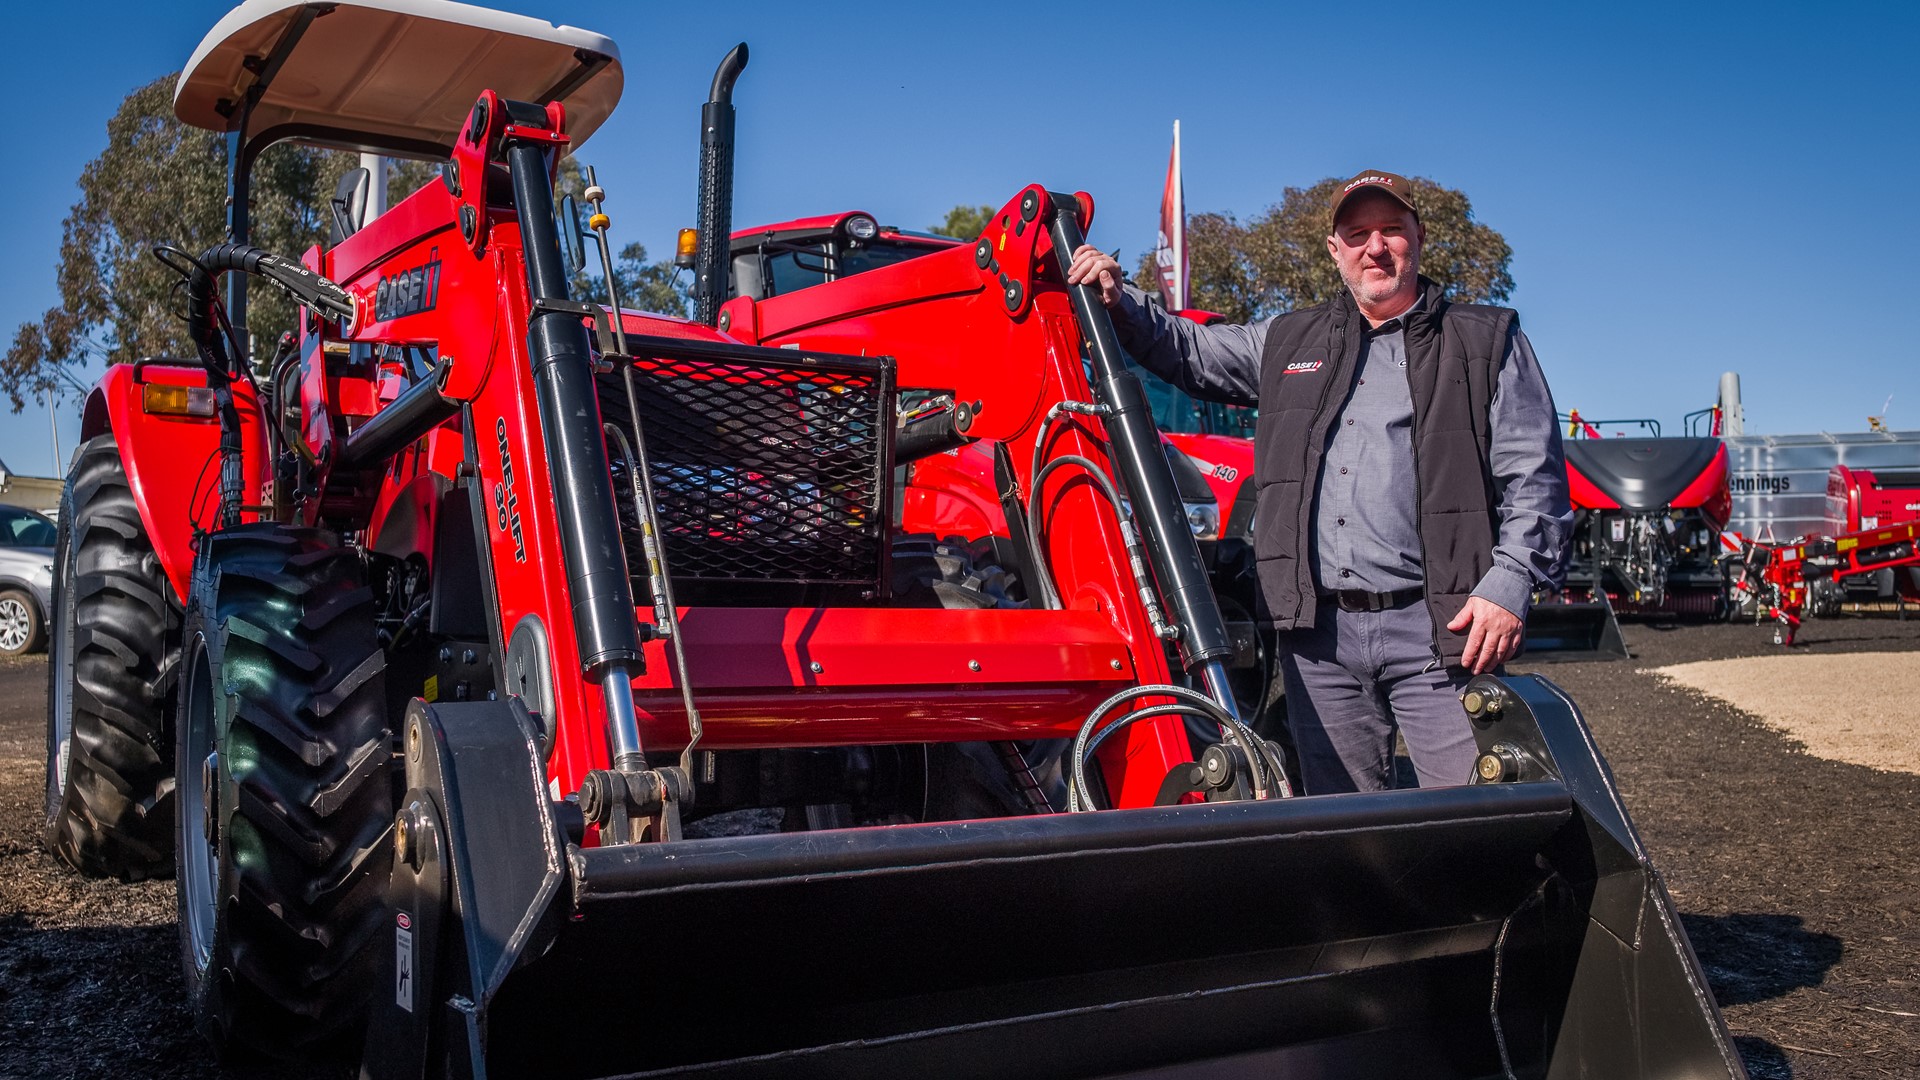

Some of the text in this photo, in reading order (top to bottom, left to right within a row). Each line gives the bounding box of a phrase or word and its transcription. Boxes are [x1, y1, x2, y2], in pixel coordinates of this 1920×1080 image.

[375, 266, 423, 323] CASE
[1287, 362, 1313, 370] CASE
[496, 416, 527, 564] ONE-LIFT
[1213, 463, 1238, 483] 140
[494, 482, 508, 532] 30
